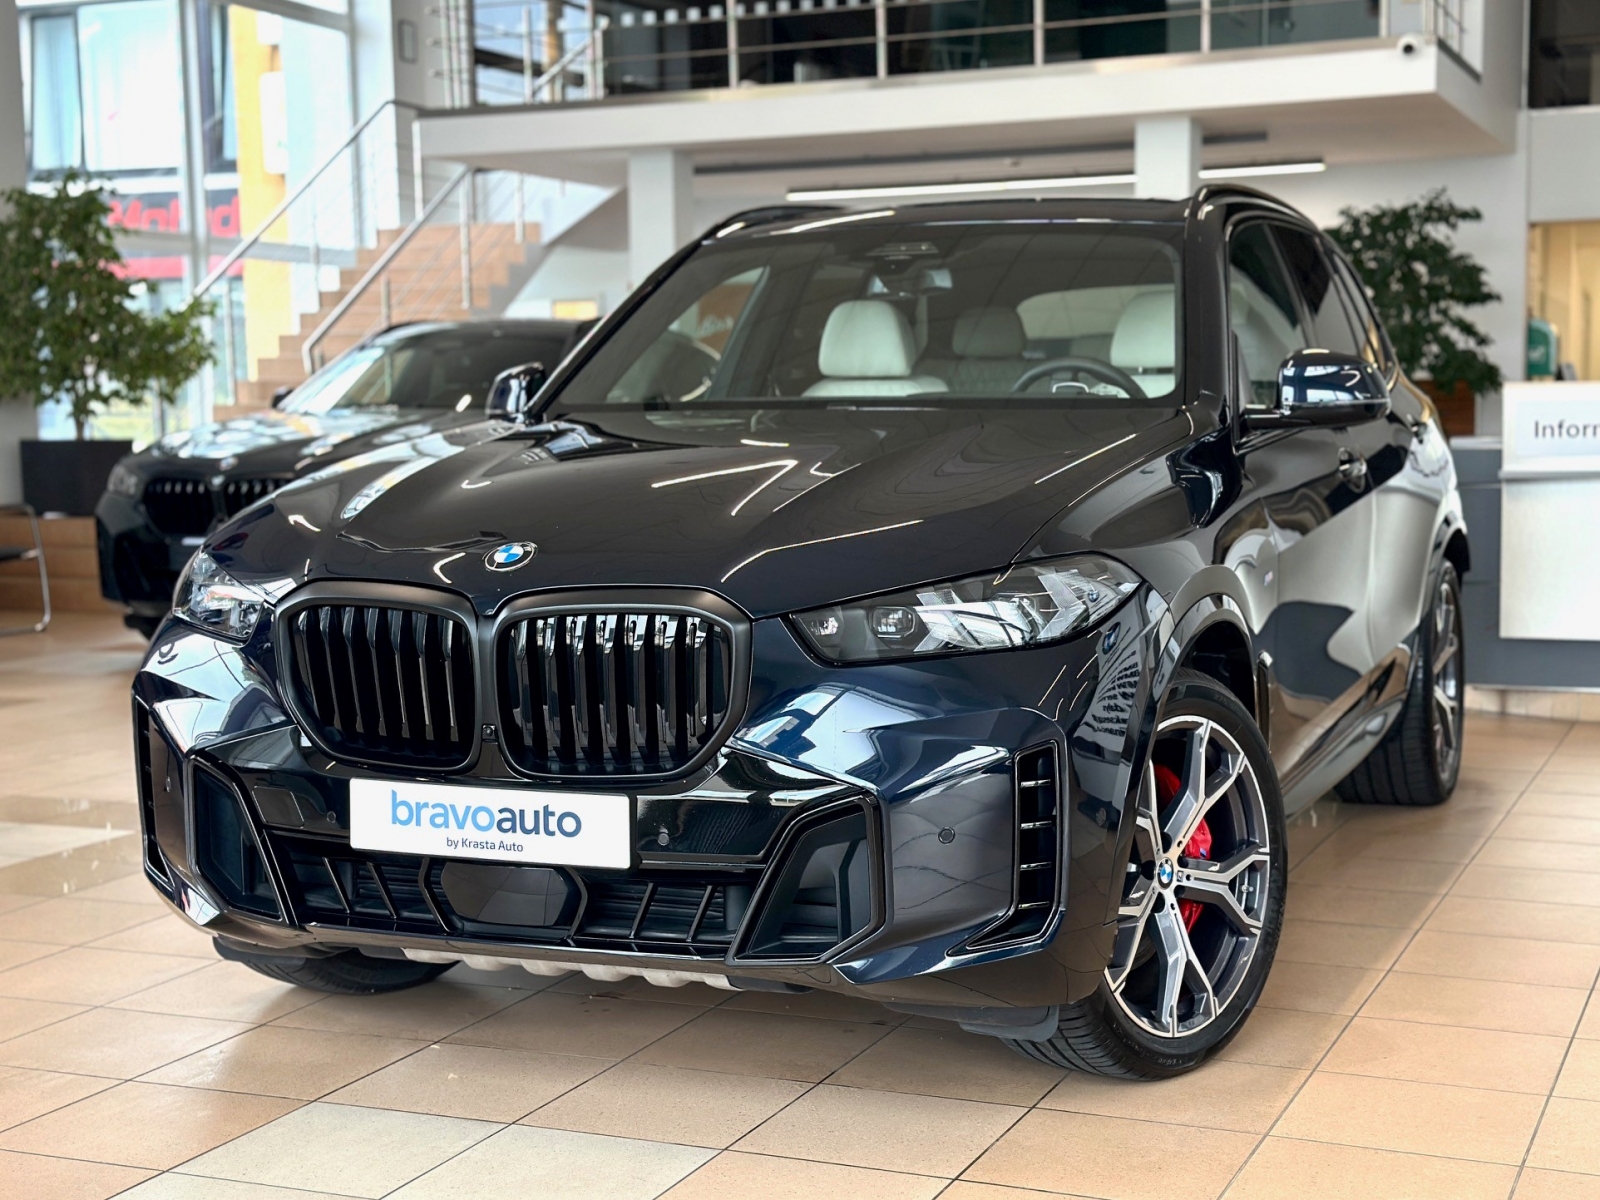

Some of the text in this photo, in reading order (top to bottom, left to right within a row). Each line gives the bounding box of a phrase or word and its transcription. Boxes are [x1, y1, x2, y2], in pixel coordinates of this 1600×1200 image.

[391, 789, 582, 838] bravoauto
[446, 837, 524, 852] by Krasta Auto
